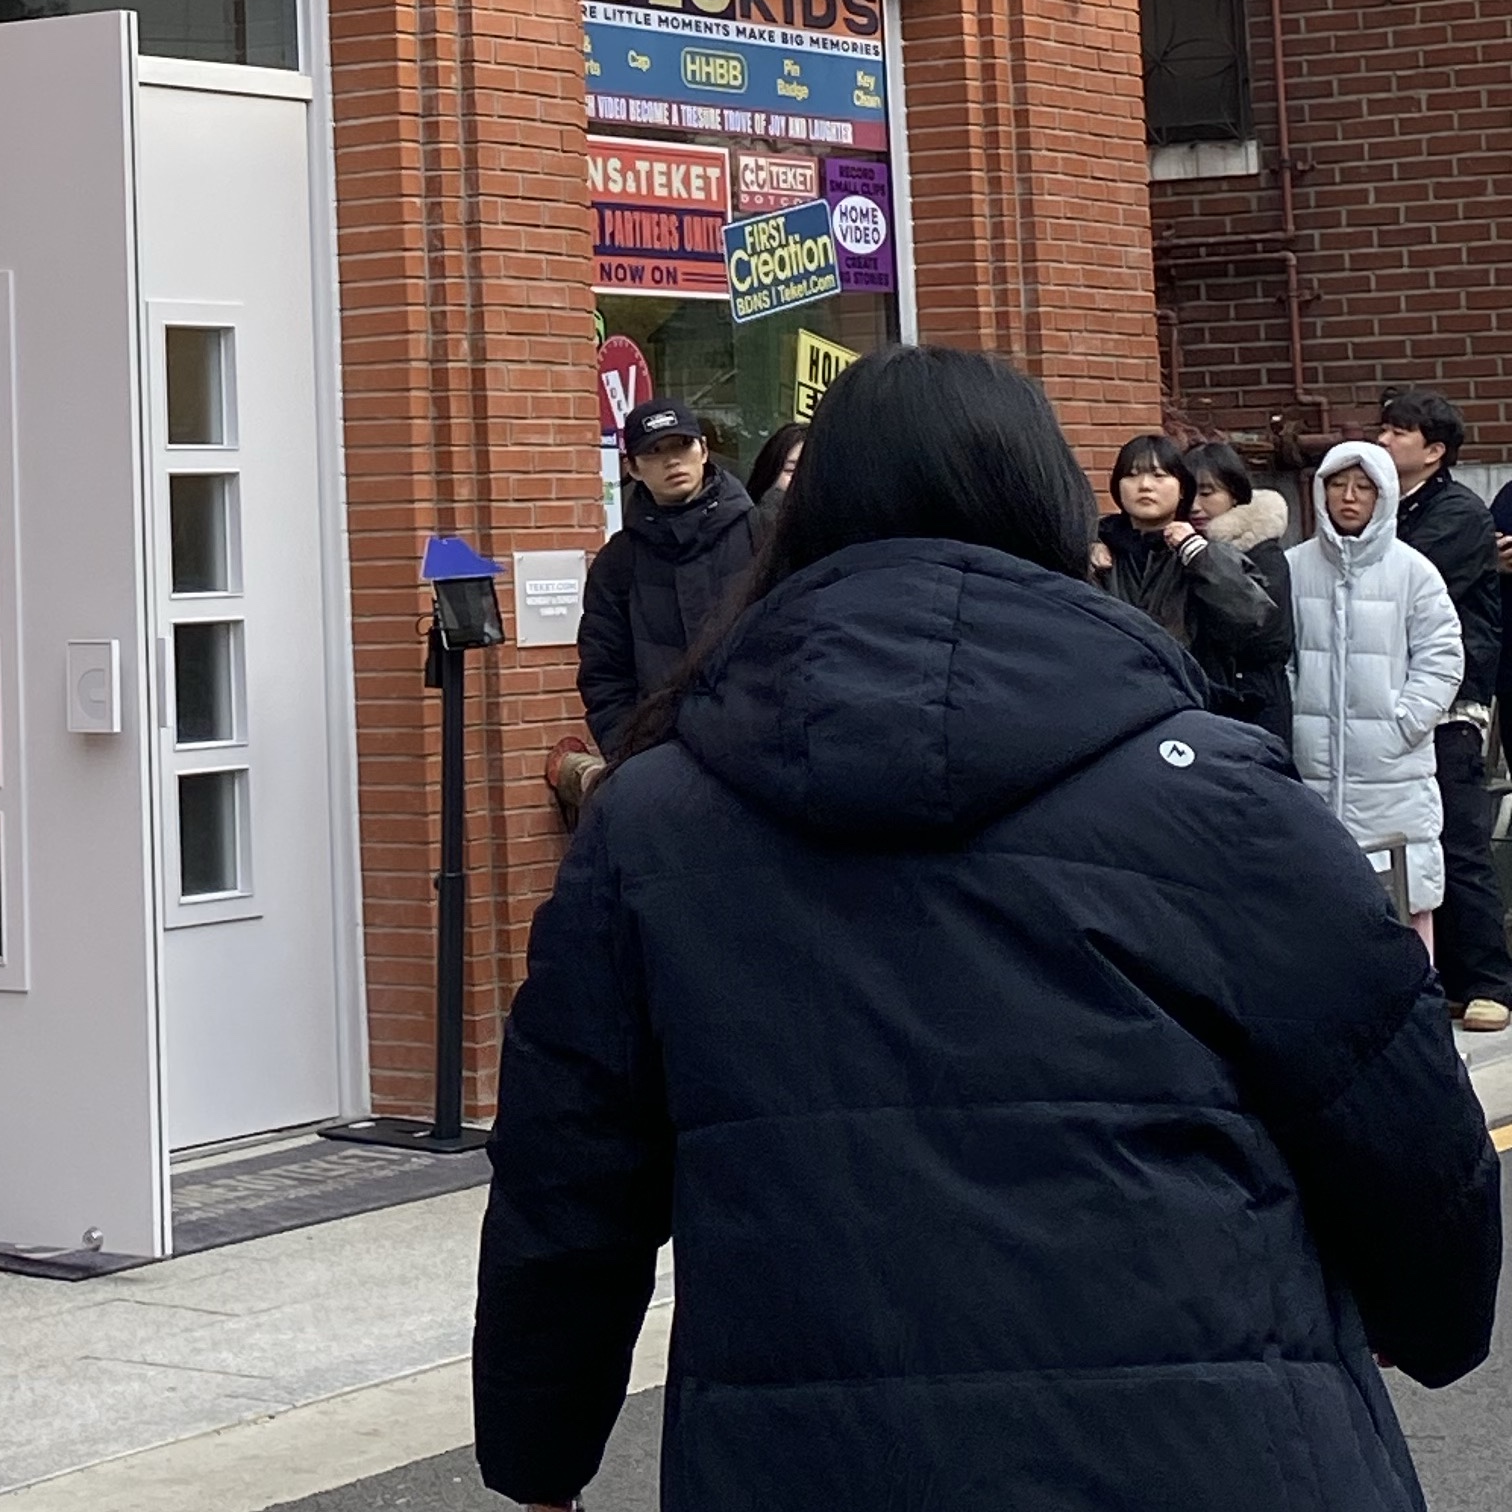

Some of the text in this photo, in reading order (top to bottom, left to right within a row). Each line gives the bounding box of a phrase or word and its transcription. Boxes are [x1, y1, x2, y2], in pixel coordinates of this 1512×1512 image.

[603, 7, 652, 27] LITTLE
[657, 14, 730, 38] MOMENTS
[735, 25, 776, 43] MAKE
[780, 31, 805, 47] BIG
[809, 35, 880, 57] MEMORIES
[686, 53, 743, 86] HHBB
[597, 95, 627, 121] VIDEO
[769, 165, 813, 192] TEKET
[839, 204, 878, 225] HOME
[744, 216, 786, 255] FIRST
[839, 224, 881, 245] VIDEO
[599, 262, 678, 285] NOW ON
[730, 234, 834, 293] Creation
